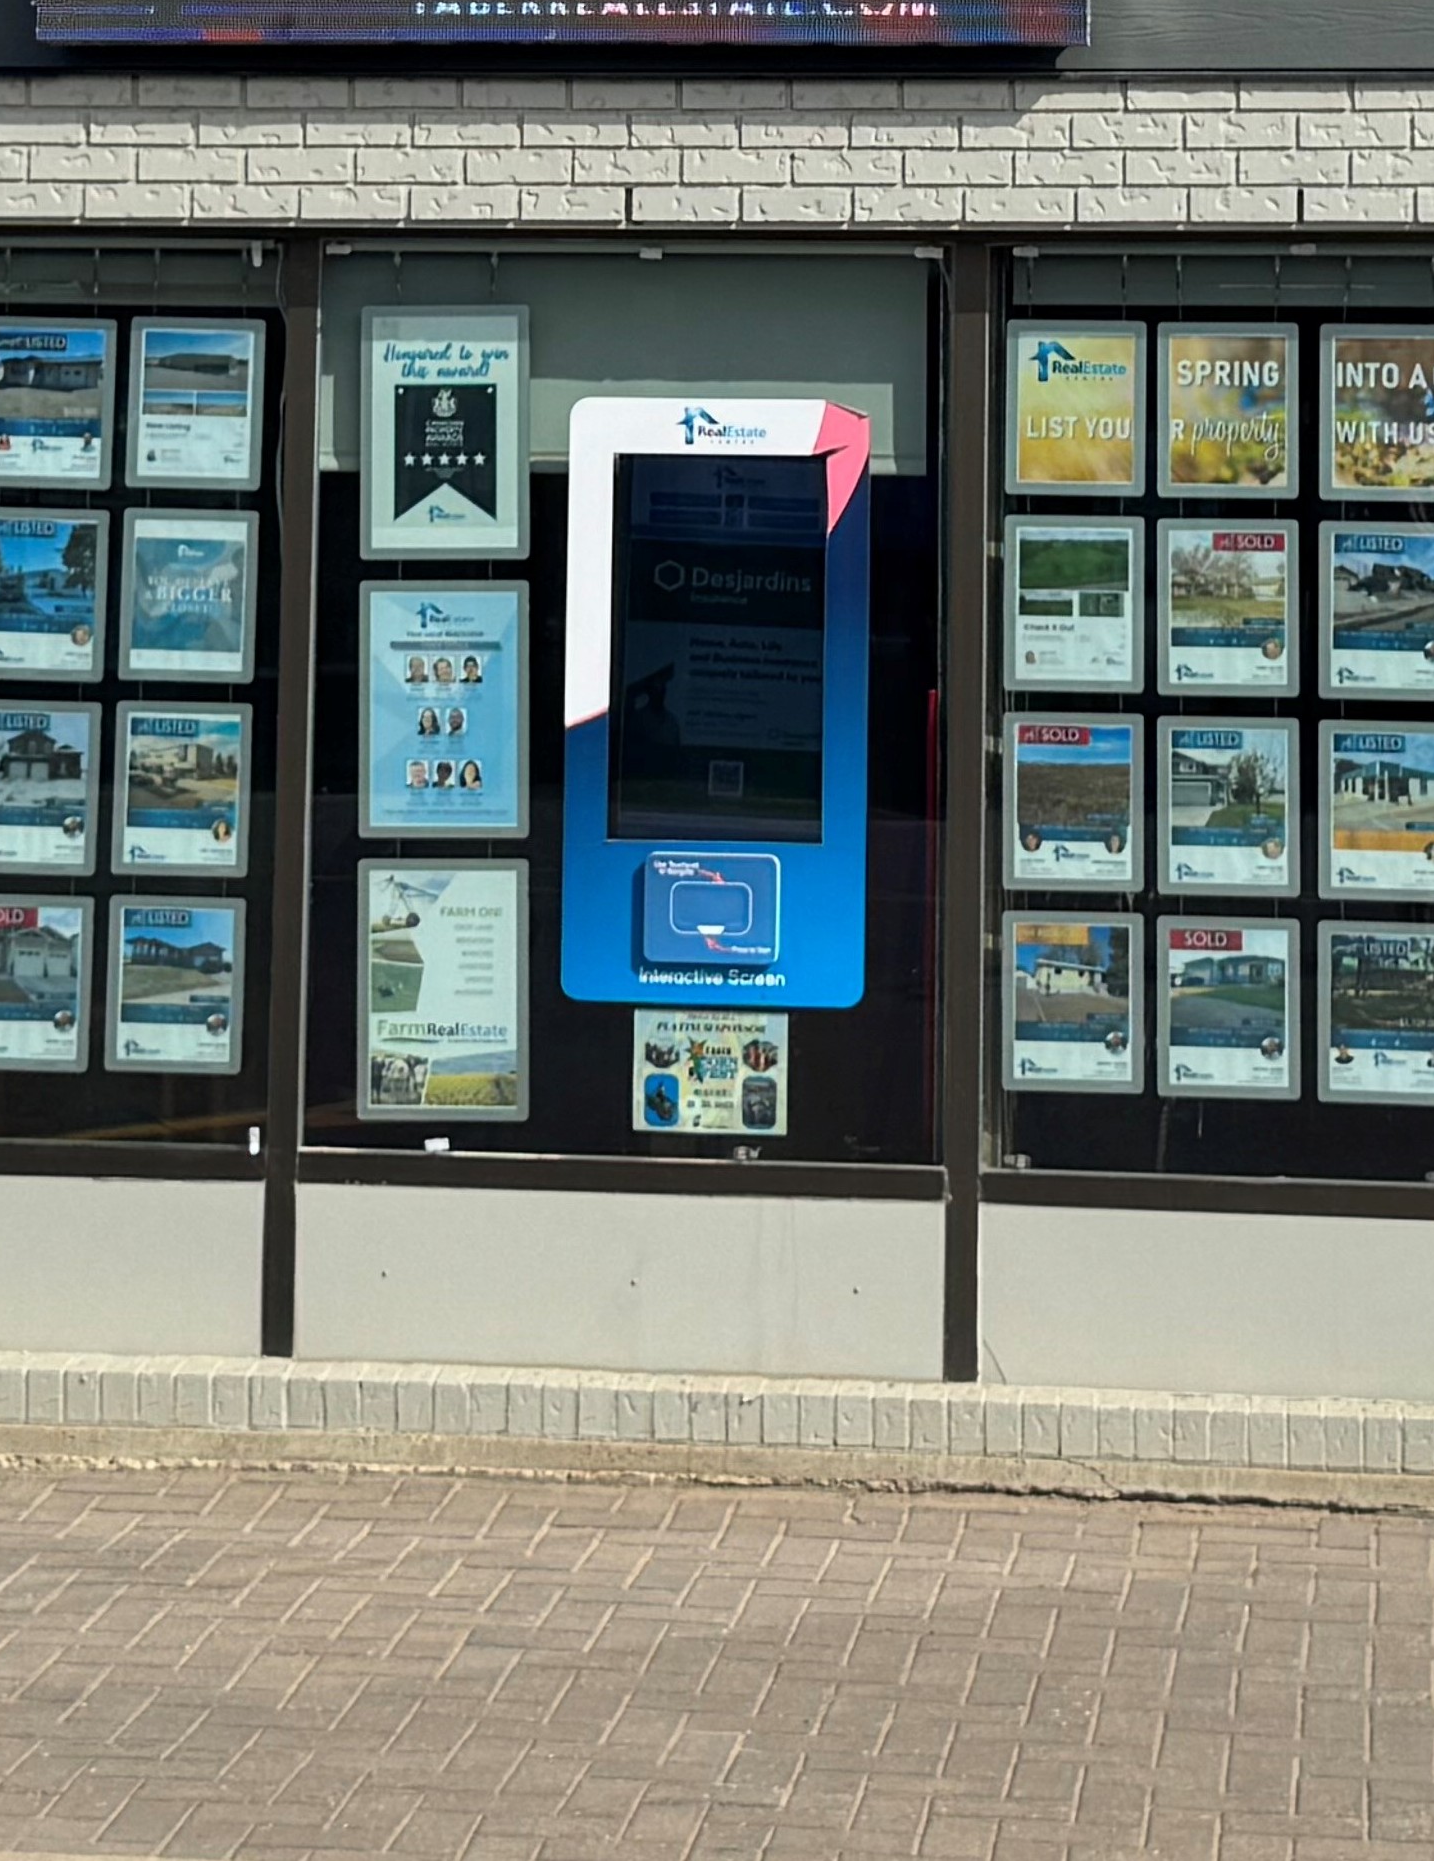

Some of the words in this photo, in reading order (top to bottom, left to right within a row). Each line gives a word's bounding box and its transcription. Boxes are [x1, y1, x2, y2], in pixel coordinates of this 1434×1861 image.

[26, 335, 67, 350] LISTED
[1052, 359, 1126, 376] RealEstate
[1177, 359, 1280, 387] SPRING
[1336, 362, 1400, 389] INTO
[698, 424, 767, 437] RealEstate
[1026, 416, 1078, 439] LIST
[1086, 416, 1133, 439] YOU
[1170, 418, 1185, 440] R
[1192, 411, 1282, 461] property
[1336, 421, 1399, 445] WITH
[14, 519, 55, 535] LISTED
[1236, 534, 1275, 549] SOLD
[1359, 537, 1404, 551] LISTED
[692, 566, 812, 594] Desjardins
[156, 585, 232, 602] BIGGER
[6, 713, 48, 728] LISTED
[154, 718, 196, 735] LISTED
[1041, 726, 1079, 742] SOLD
[1195, 731, 1239, 746] LISTED
[1359, 735, 1402, 750] LISTED
[147, 909, 190, 925] LISTED
[440, 906, 476, 917] FARM
[1184, 929, 1227, 947] SOLD
[637, 966, 725, 986] Interactive
[727, 968, 787, 987] Screen
[376, 1018, 508, 1038] FarmRealEstate
